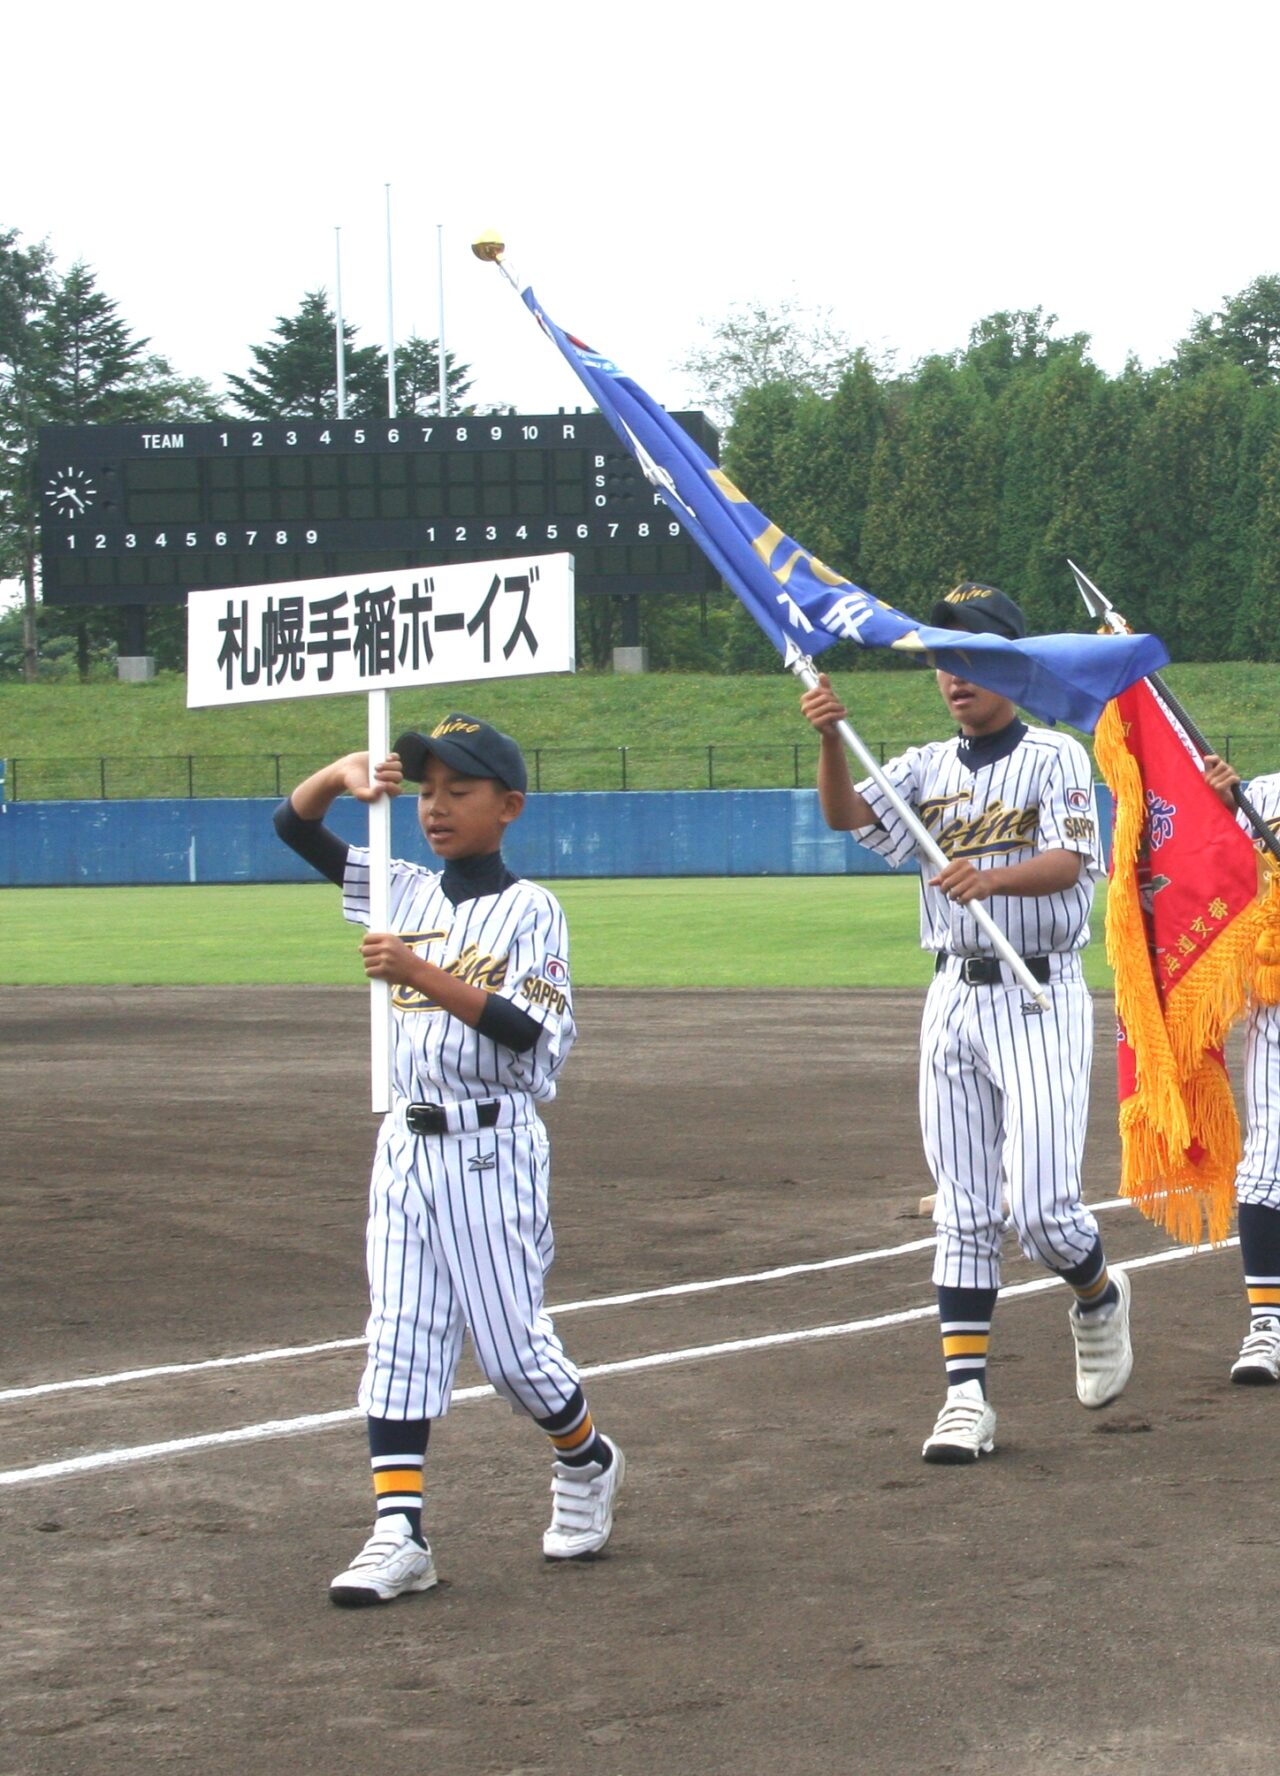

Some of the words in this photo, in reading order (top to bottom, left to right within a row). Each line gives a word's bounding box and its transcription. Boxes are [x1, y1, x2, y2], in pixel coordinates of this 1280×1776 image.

[141, 433, 184, 449] TEAM
[219, 432, 228, 447] 1
[251, 431, 263, 447] 2
[286, 430, 298, 446] 3
[319, 429, 332, 445] 4
[354, 429, 366, 444] 5
[387, 428, 400, 443] 6
[421, 427, 433, 443] 7
[455, 426, 468, 442] 8
[490, 426, 503, 441] 9
[521, 425, 539, 440] 10
[562, 424, 575, 440] R
[594, 454, 605, 468] B
[594, 473, 606, 488] S
[594, 494, 607, 507] O
[67, 534, 75, 549] 1
[95, 534, 107, 549] 2
[125, 533, 137, 548] 3
[155, 532, 167, 547] 4
[185, 532, 197, 547] 5
[215, 531, 227, 546] 6
[245, 530, 258, 546] 7
[275, 530, 288, 545] 8
[305, 529, 318, 545] 9
[426, 527, 435, 542] 1
[455, 526, 467, 542] 2
[485, 525, 497, 541] 3
[515, 525, 528, 540] 4
[546, 524, 558, 539] 5
[576, 523, 589, 539] 6
[607, 522, 619, 538] 7
[637, 522, 650, 537] 8
[668, 521, 680, 537] 9
[217, 565, 540, 690] 札幌手稲ボーイズ
[919, 791, 1041, 853] Teine
[1063, 816, 1096, 839] SAPP
[520, 976, 567, 1016] SAPPO
